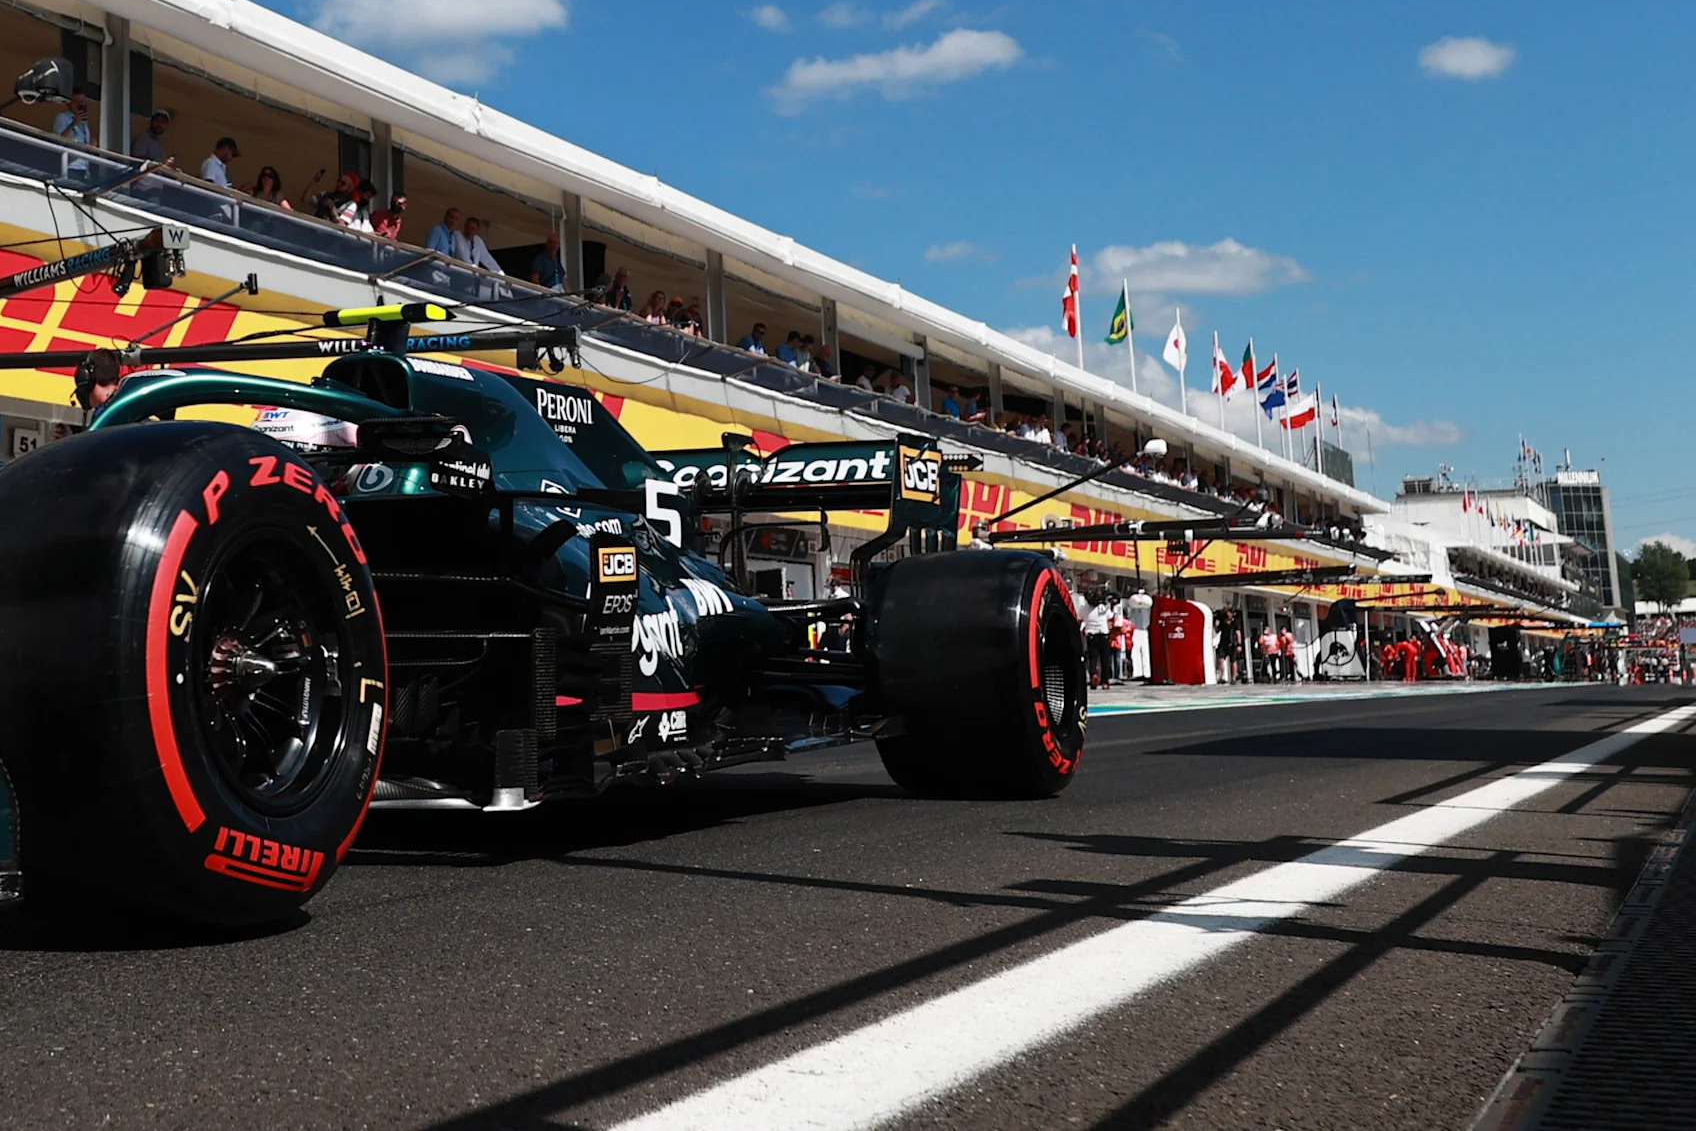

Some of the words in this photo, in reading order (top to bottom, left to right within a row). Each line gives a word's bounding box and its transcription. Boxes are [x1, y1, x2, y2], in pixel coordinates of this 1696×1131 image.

[169, 229, 184, 243] W
[14, 261, 67, 287] WILLIAMS
[67, 247, 110, 272] RACING
[407, 336, 470, 349] RACING
[536, 387, 594, 424] PERONI
[19, 436, 37, 453] 51
[431, 473, 485, 489] OAKLEY
[904, 457, 939, 492] JCB
[202, 470, 230, 525] P
[248, 455, 368, 565] ZERO
[645, 478, 682, 548] 5
[604, 554, 634, 575] JCB
[204, 826, 324, 892] PIRELLI
